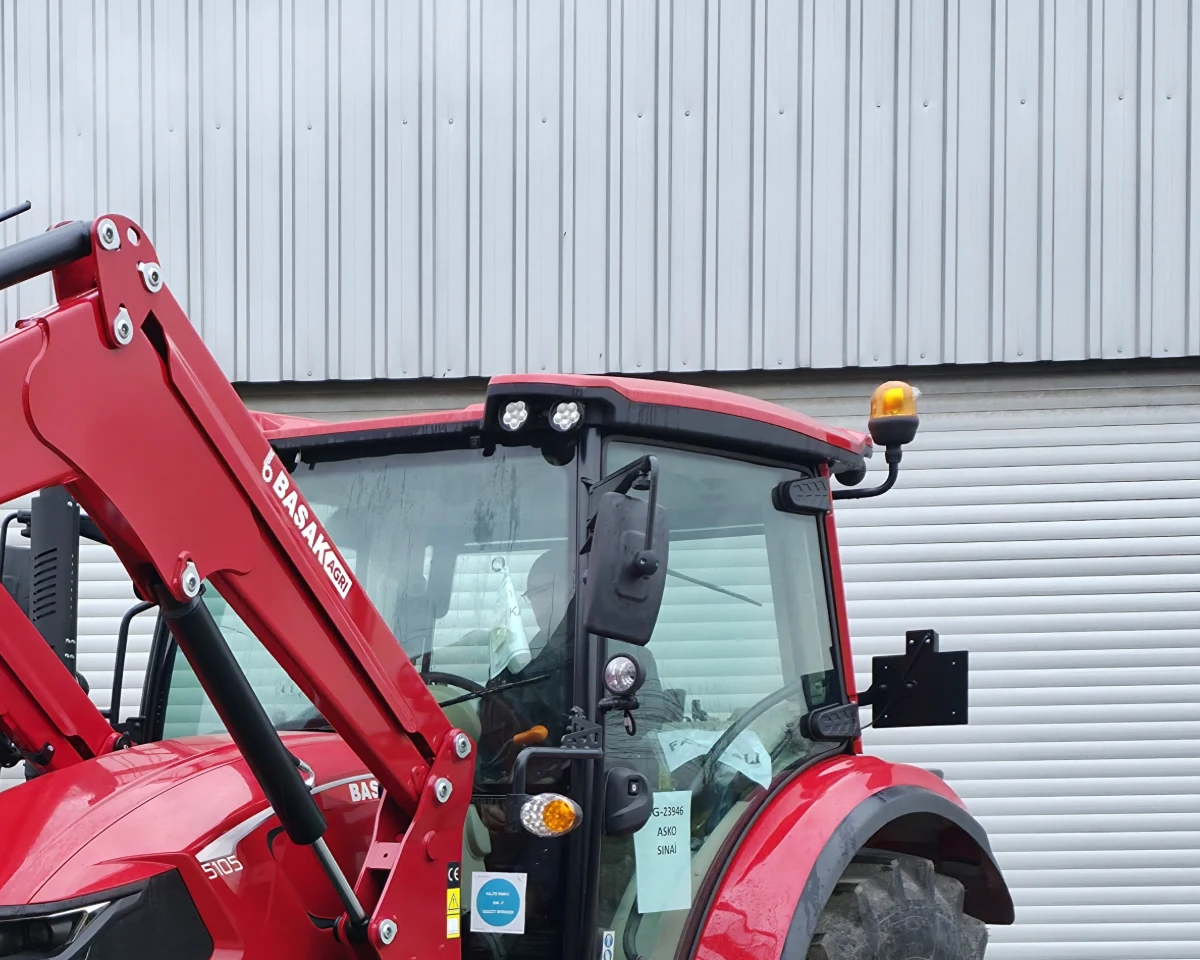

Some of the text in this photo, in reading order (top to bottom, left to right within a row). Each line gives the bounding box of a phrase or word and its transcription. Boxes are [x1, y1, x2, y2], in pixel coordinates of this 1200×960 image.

[272, 470, 350, 594] BASAK AGRI
[652, 805, 684, 817] G-23946
[656, 825, 677, 837] ASKO
[200, 855, 244, 880] 5105
